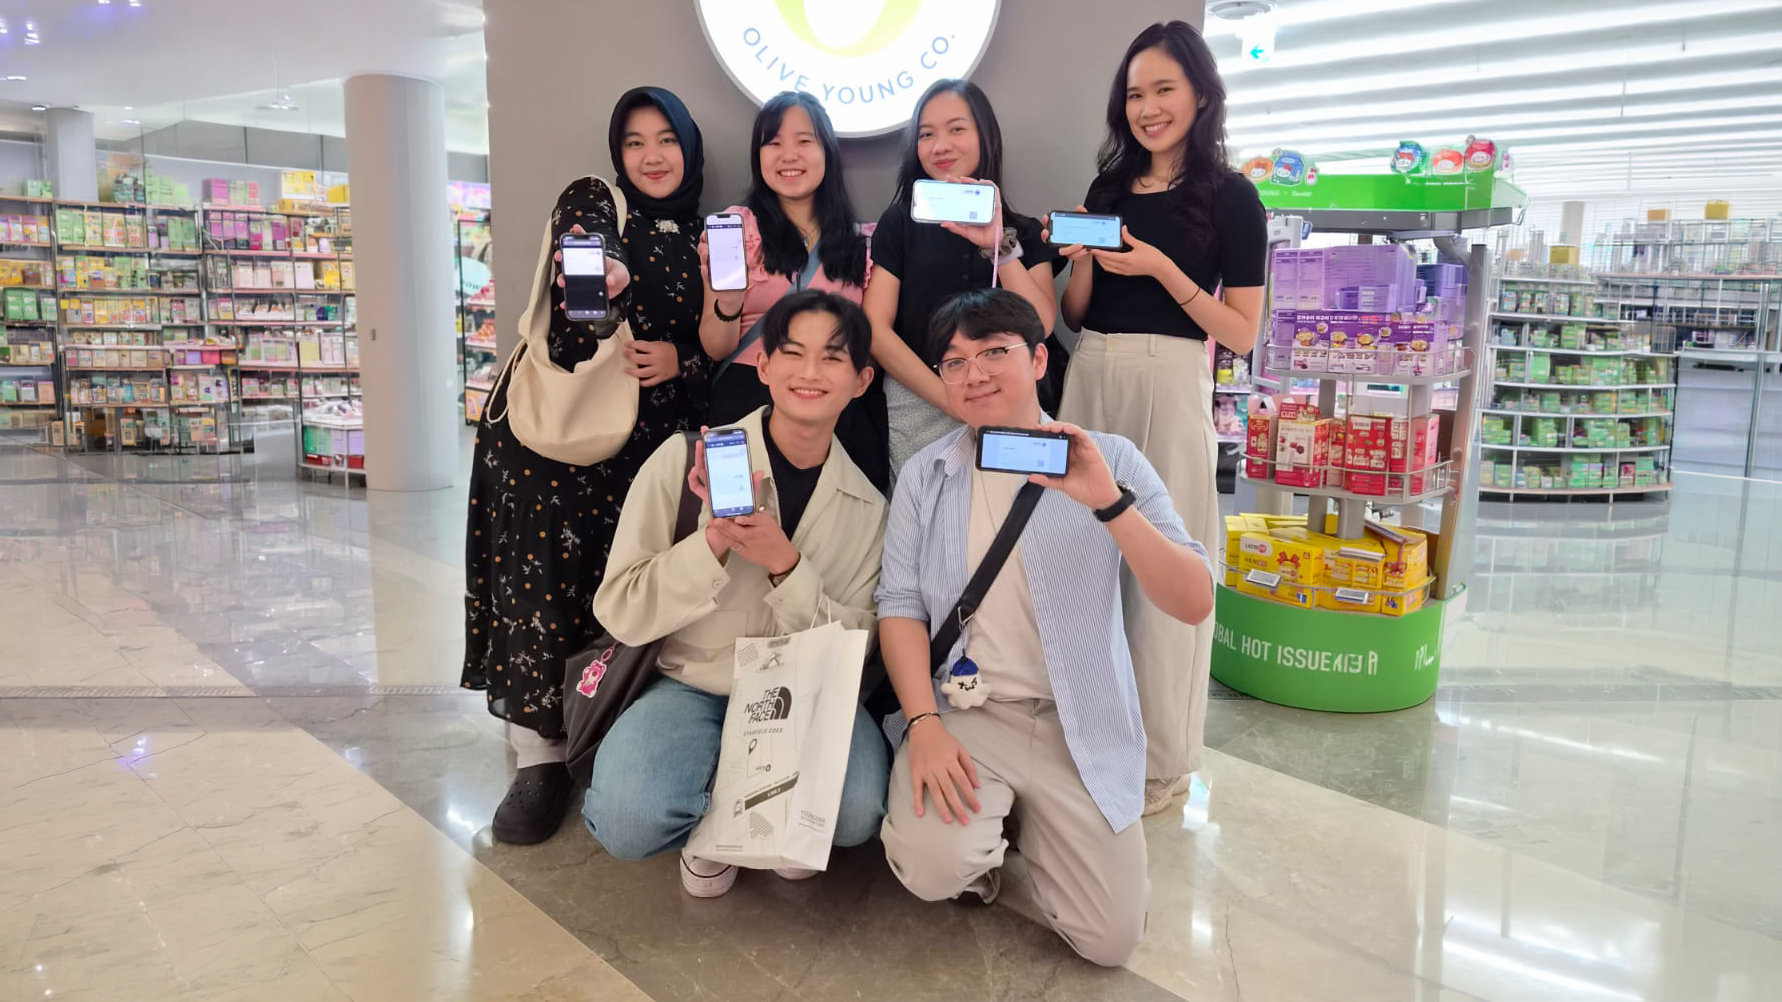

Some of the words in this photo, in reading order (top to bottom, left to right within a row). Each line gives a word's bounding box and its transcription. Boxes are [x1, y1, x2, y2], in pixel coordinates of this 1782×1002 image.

[743, 27, 810, 92] OLIVE
[822, 70, 914, 105] YOUNG
[920, 34, 955, 70] CO.
[1241, 634, 1272, 661] HOT
[1276, 644, 1332, 672] ISSUE
[763, 687, 778, 700] THE
[744, 699, 775, 714] NORTH
[748, 709, 770, 724] FACE
